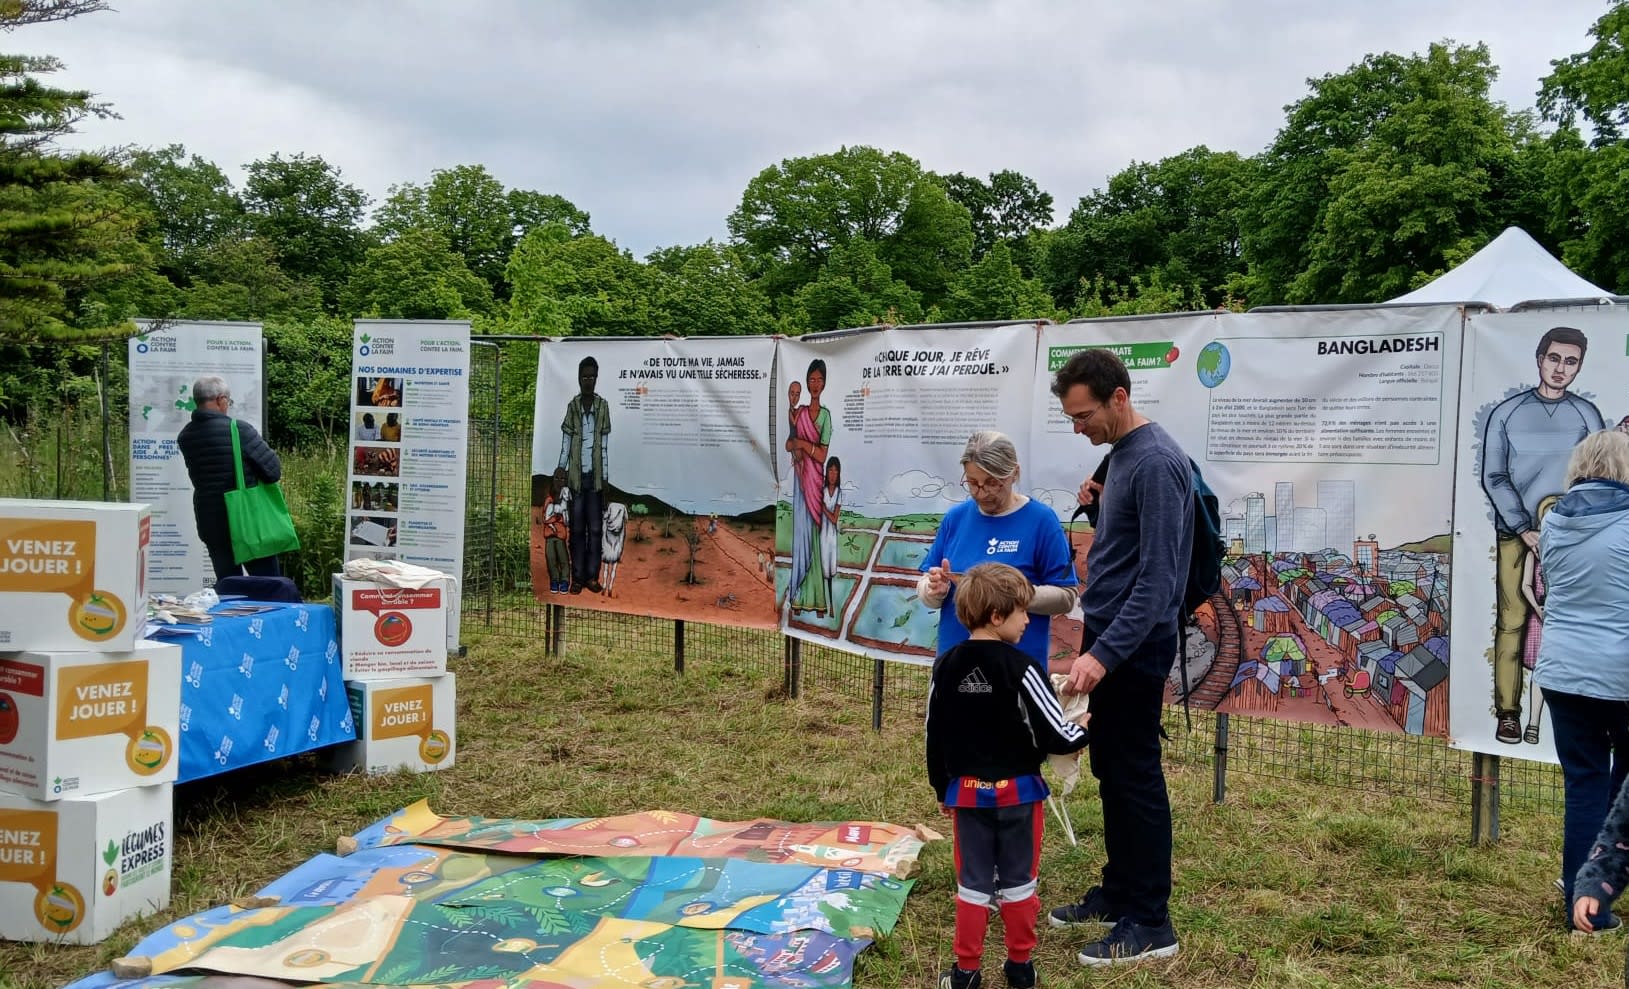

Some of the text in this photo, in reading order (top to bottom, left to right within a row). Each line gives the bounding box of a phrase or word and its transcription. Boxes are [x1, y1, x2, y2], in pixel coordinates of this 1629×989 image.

[1317, 336, 1439, 356] BANGLADESH
[662, 357, 687, 367] TOUTE
[688, 357, 699, 367] MA
[701, 357, 714, 368] VIE,
[717, 356, 745, 367] JAMAIS
[911, 351, 946, 364] JOUR,
[949, 351, 963, 362] JE
[964, 347, 991, 362] RÊVE
[358, 366, 463, 376] NOS DOMAINES D'EXPERTISE
[618, 369, 628, 379] JE
[629, 369, 664, 379] N'AVAIS
[665, 369, 677, 379] VU
[678, 369, 697, 379] UNE
[862, 367, 872, 379] DE
[873, 366, 881, 378] LA
[904, 364, 928, 377] QUE
[929, 365, 951, 376] J'AI
[7, 539, 77, 556] VENEZ
[0, 557, 69, 575] JOUER
[76, 681, 133, 701] VENEZ
[958, 683, 993, 693] adidas
[69, 700, 126, 721] JOUER
[384, 699, 423, 714] VENEZ
[380, 712, 419, 728] JOUER
[0, 828, 41, 846] NEZ
[121, 820, 165, 858] LÉGUMES
[0, 847, 35, 865] UER
[121, 842, 165, 874] EXPRESS
